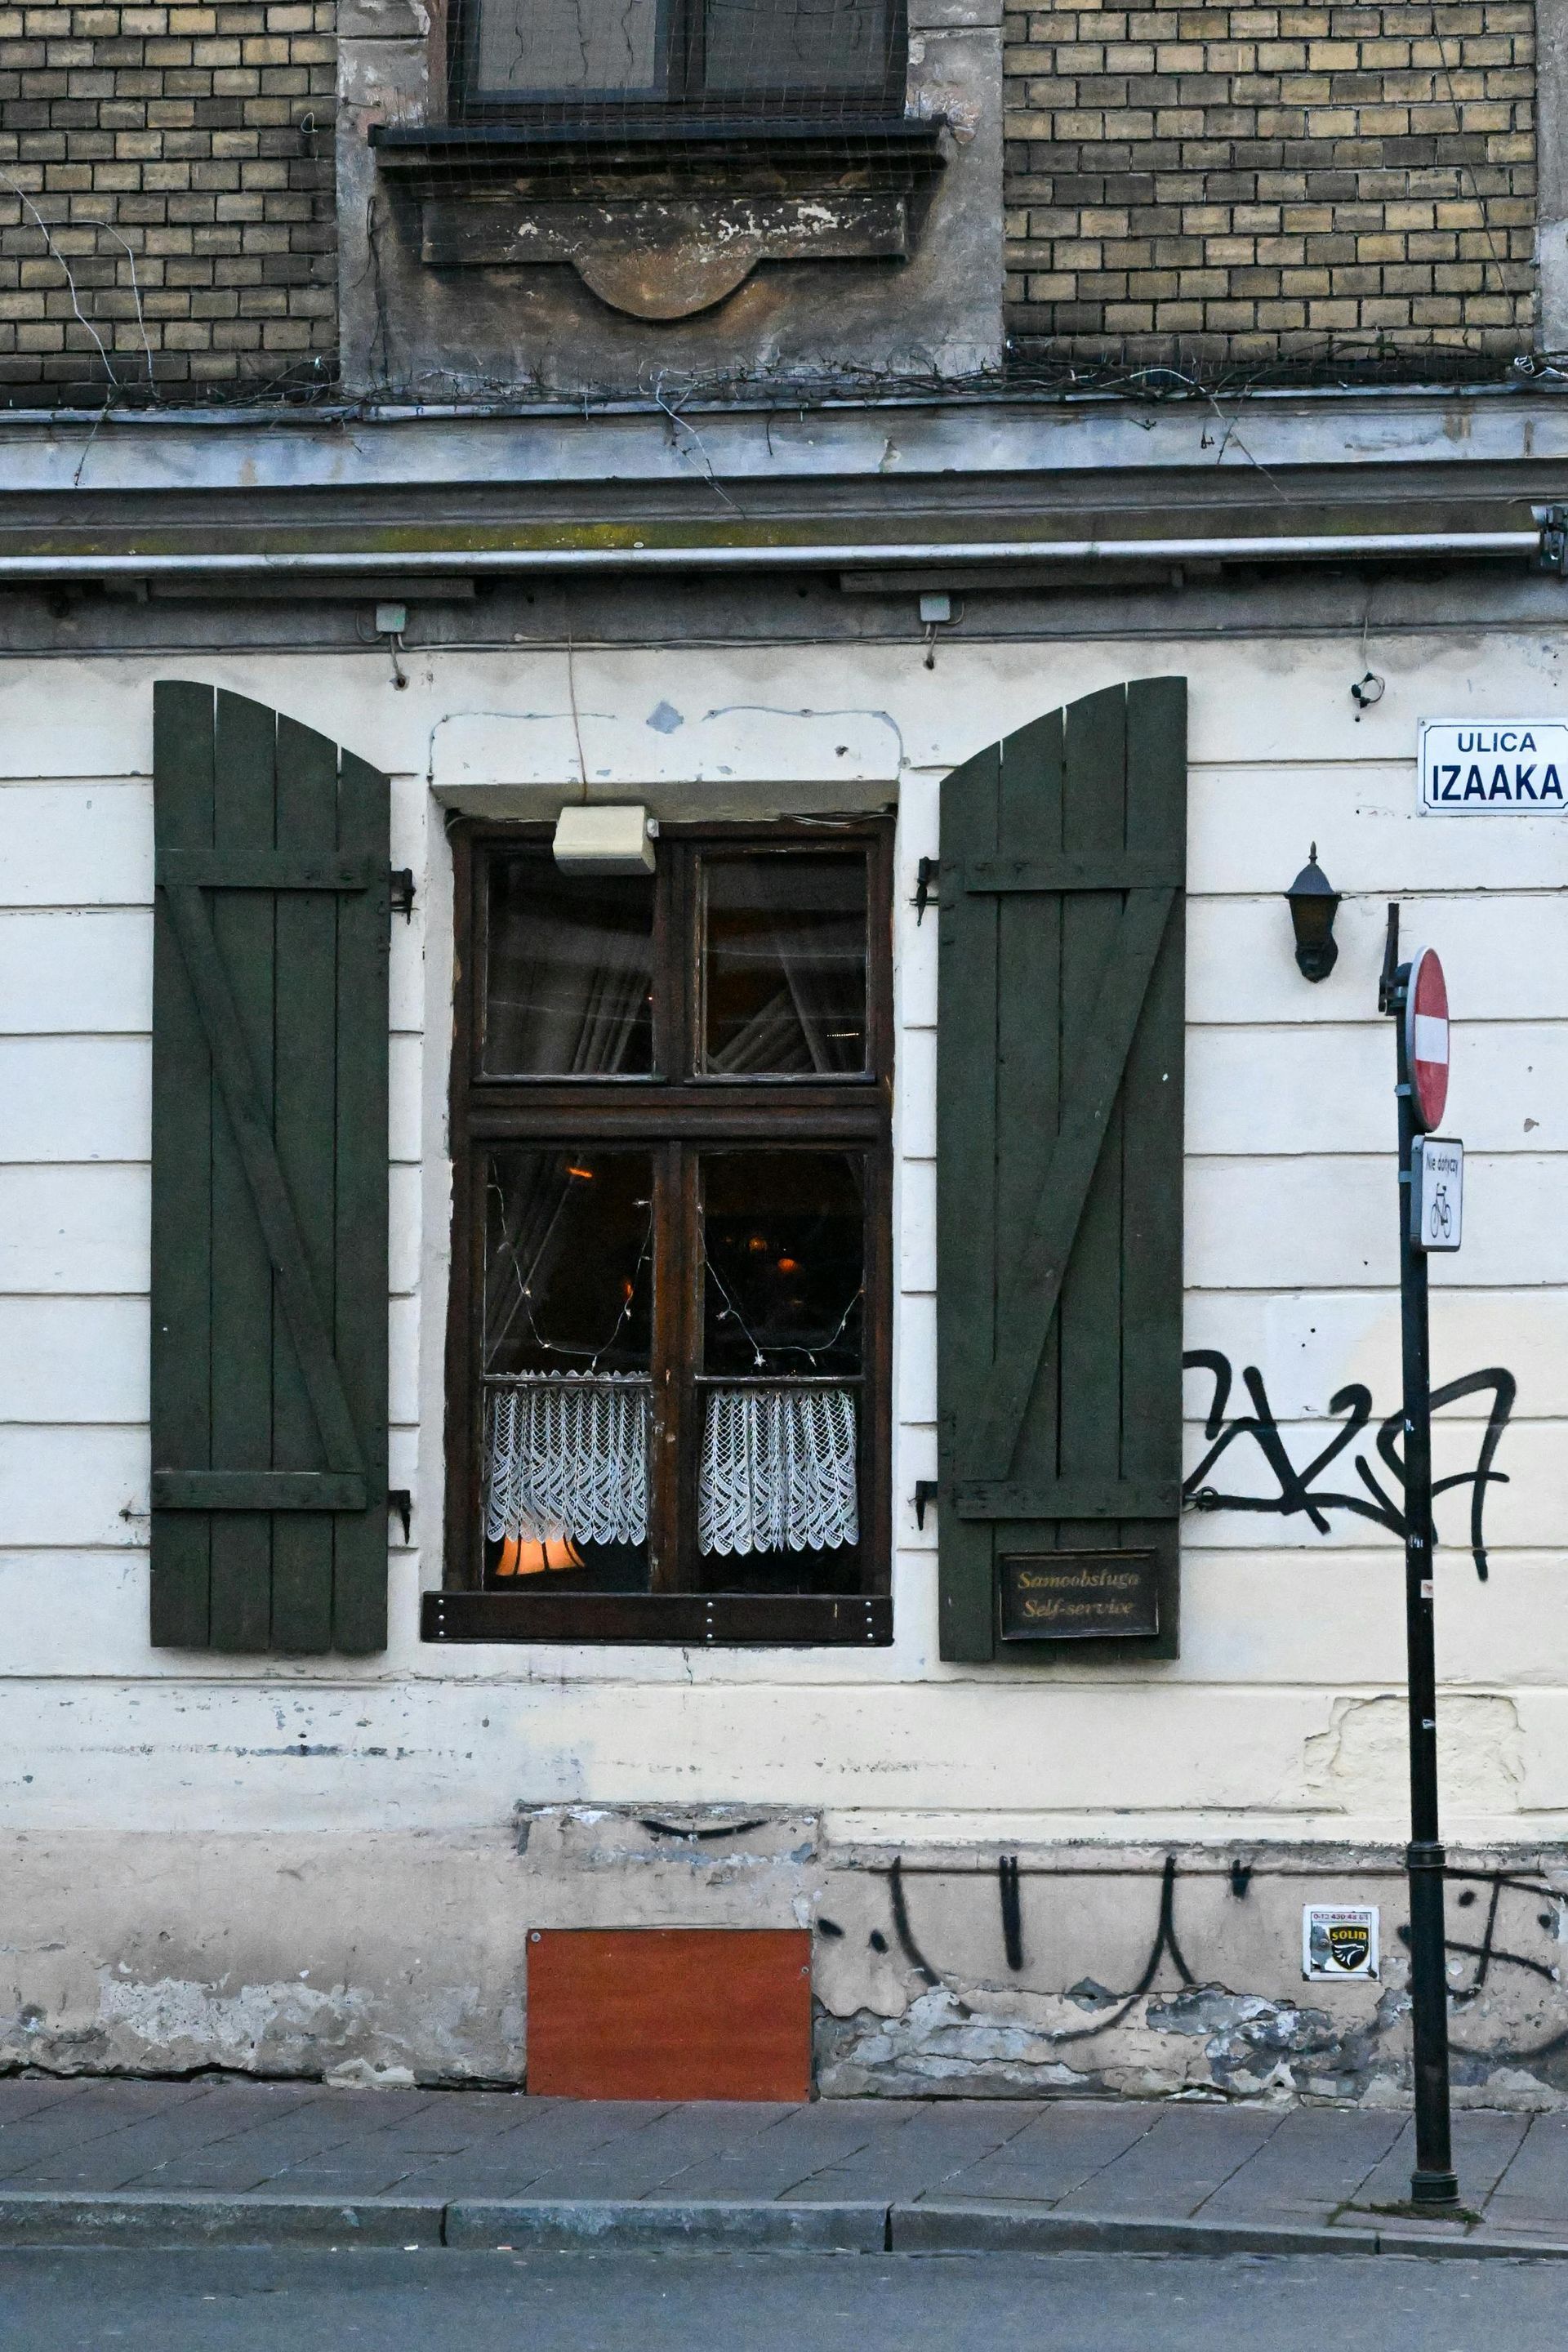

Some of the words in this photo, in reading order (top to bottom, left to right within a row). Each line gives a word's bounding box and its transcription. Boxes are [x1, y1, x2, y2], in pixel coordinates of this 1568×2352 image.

[1458, 732, 1537, 752] ULICA
[1433, 764, 1563, 800] IZAAKA
[1022, 1597, 1135, 1620] Self-service
[1332, 1930, 1367, 1940] SOLID
